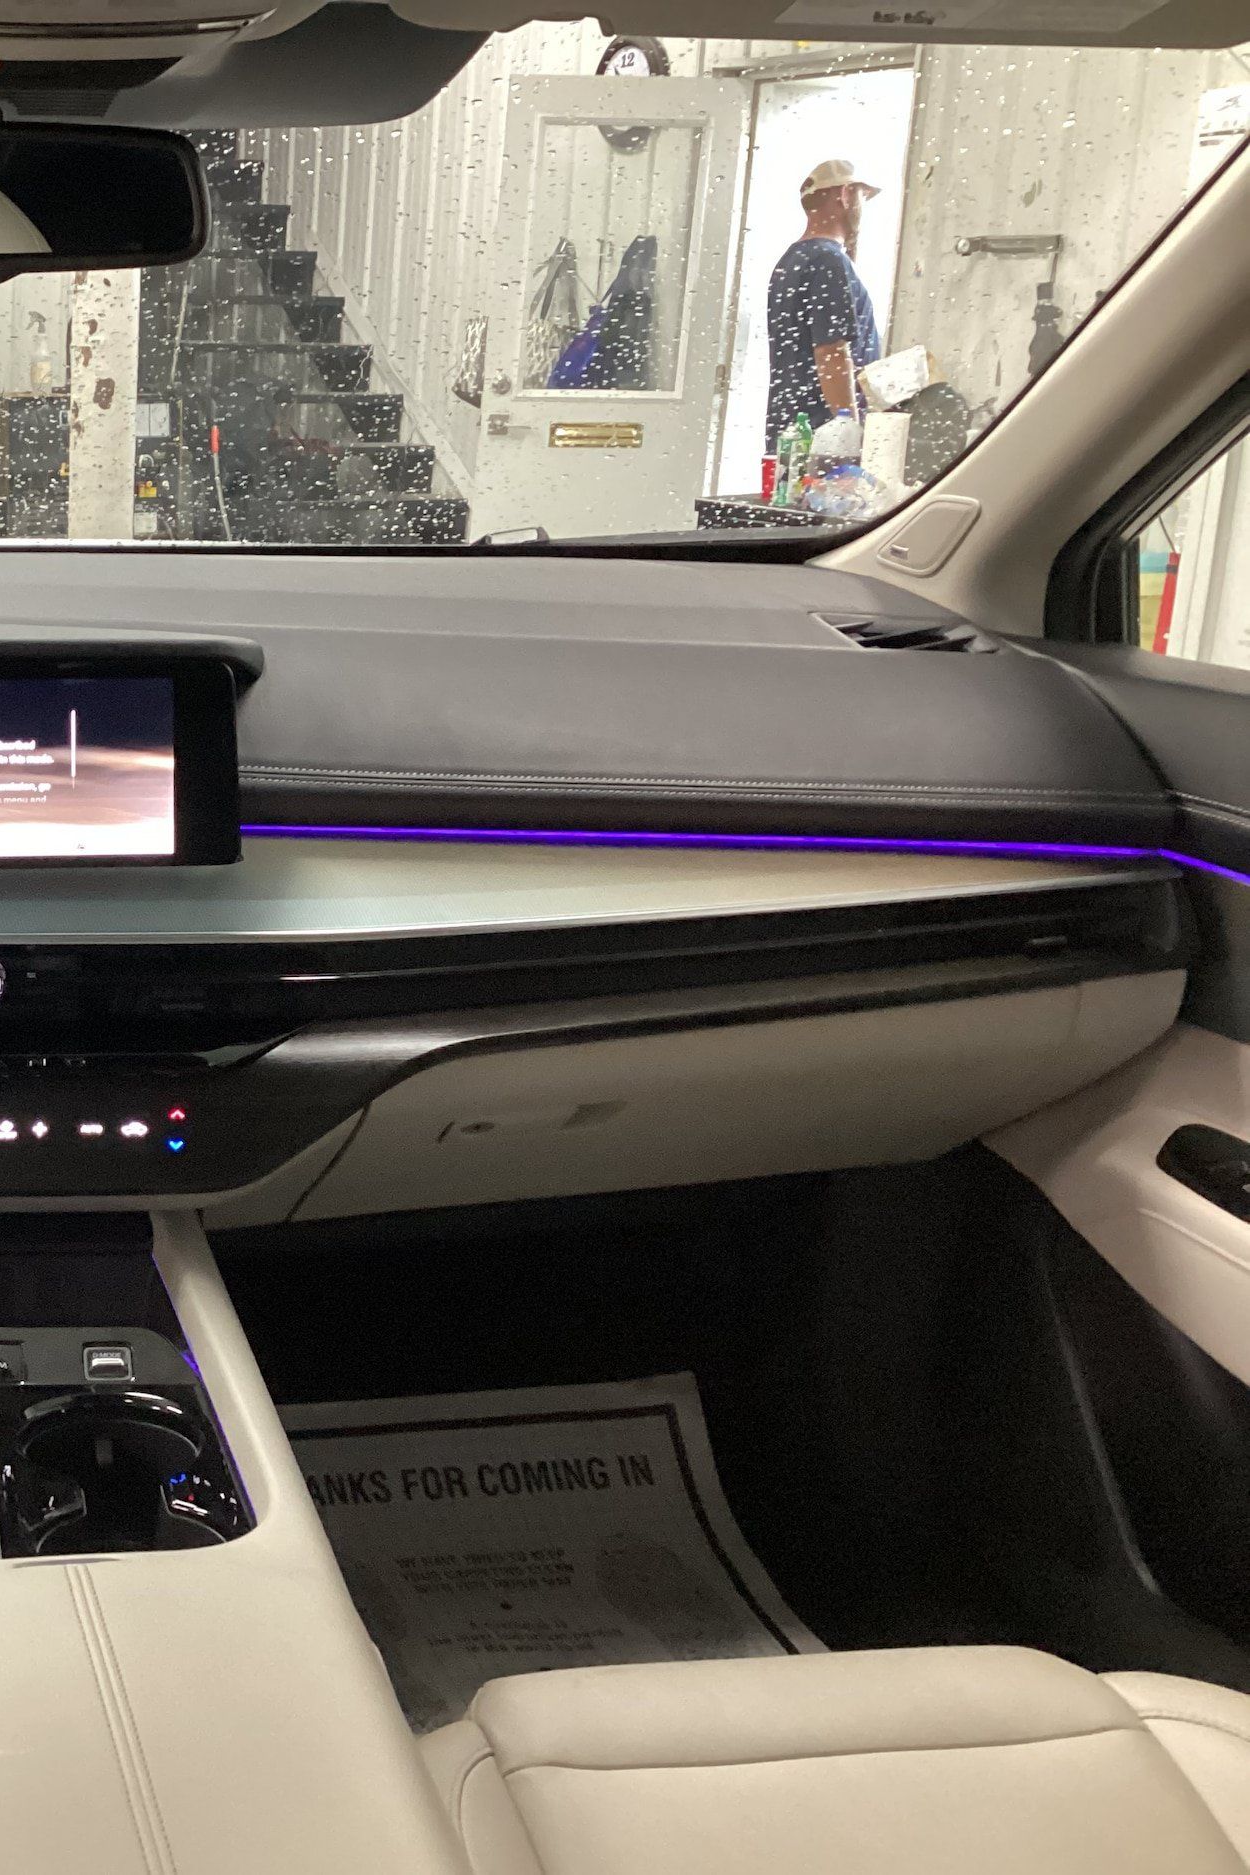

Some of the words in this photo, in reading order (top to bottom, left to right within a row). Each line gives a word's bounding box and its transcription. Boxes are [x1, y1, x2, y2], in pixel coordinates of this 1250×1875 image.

[621, 52, 635, 68] 12
[306, 1470, 392, 1506] ANKS
[401, 1466, 469, 1501] FOR
[476, 1457, 610, 1497] COMING
[616, 1454, 654, 1487] IN
